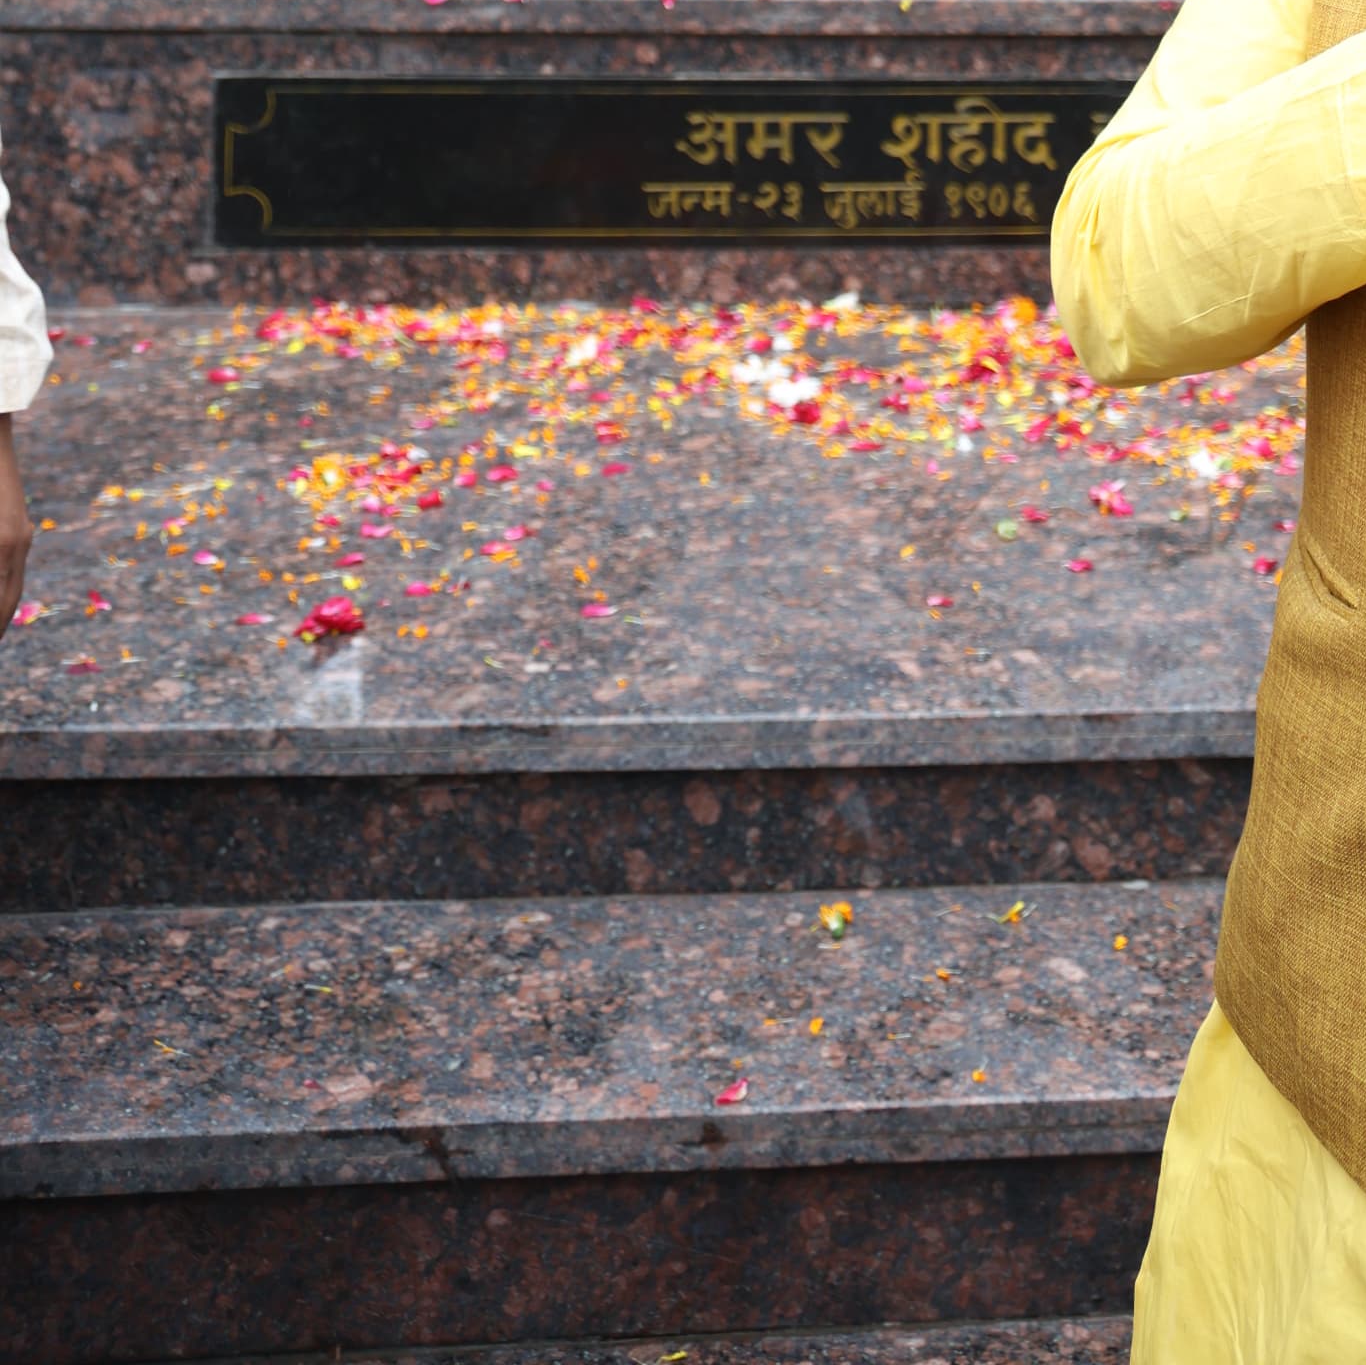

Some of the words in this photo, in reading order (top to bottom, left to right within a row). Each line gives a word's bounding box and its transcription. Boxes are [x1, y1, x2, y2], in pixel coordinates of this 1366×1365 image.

[675, 111, 849, 168] अमर
[880, 96, 1057, 173] शहीद
[819, 170, 926, 230] जुलाई
[944, 181, 1038, 222] १९०६
